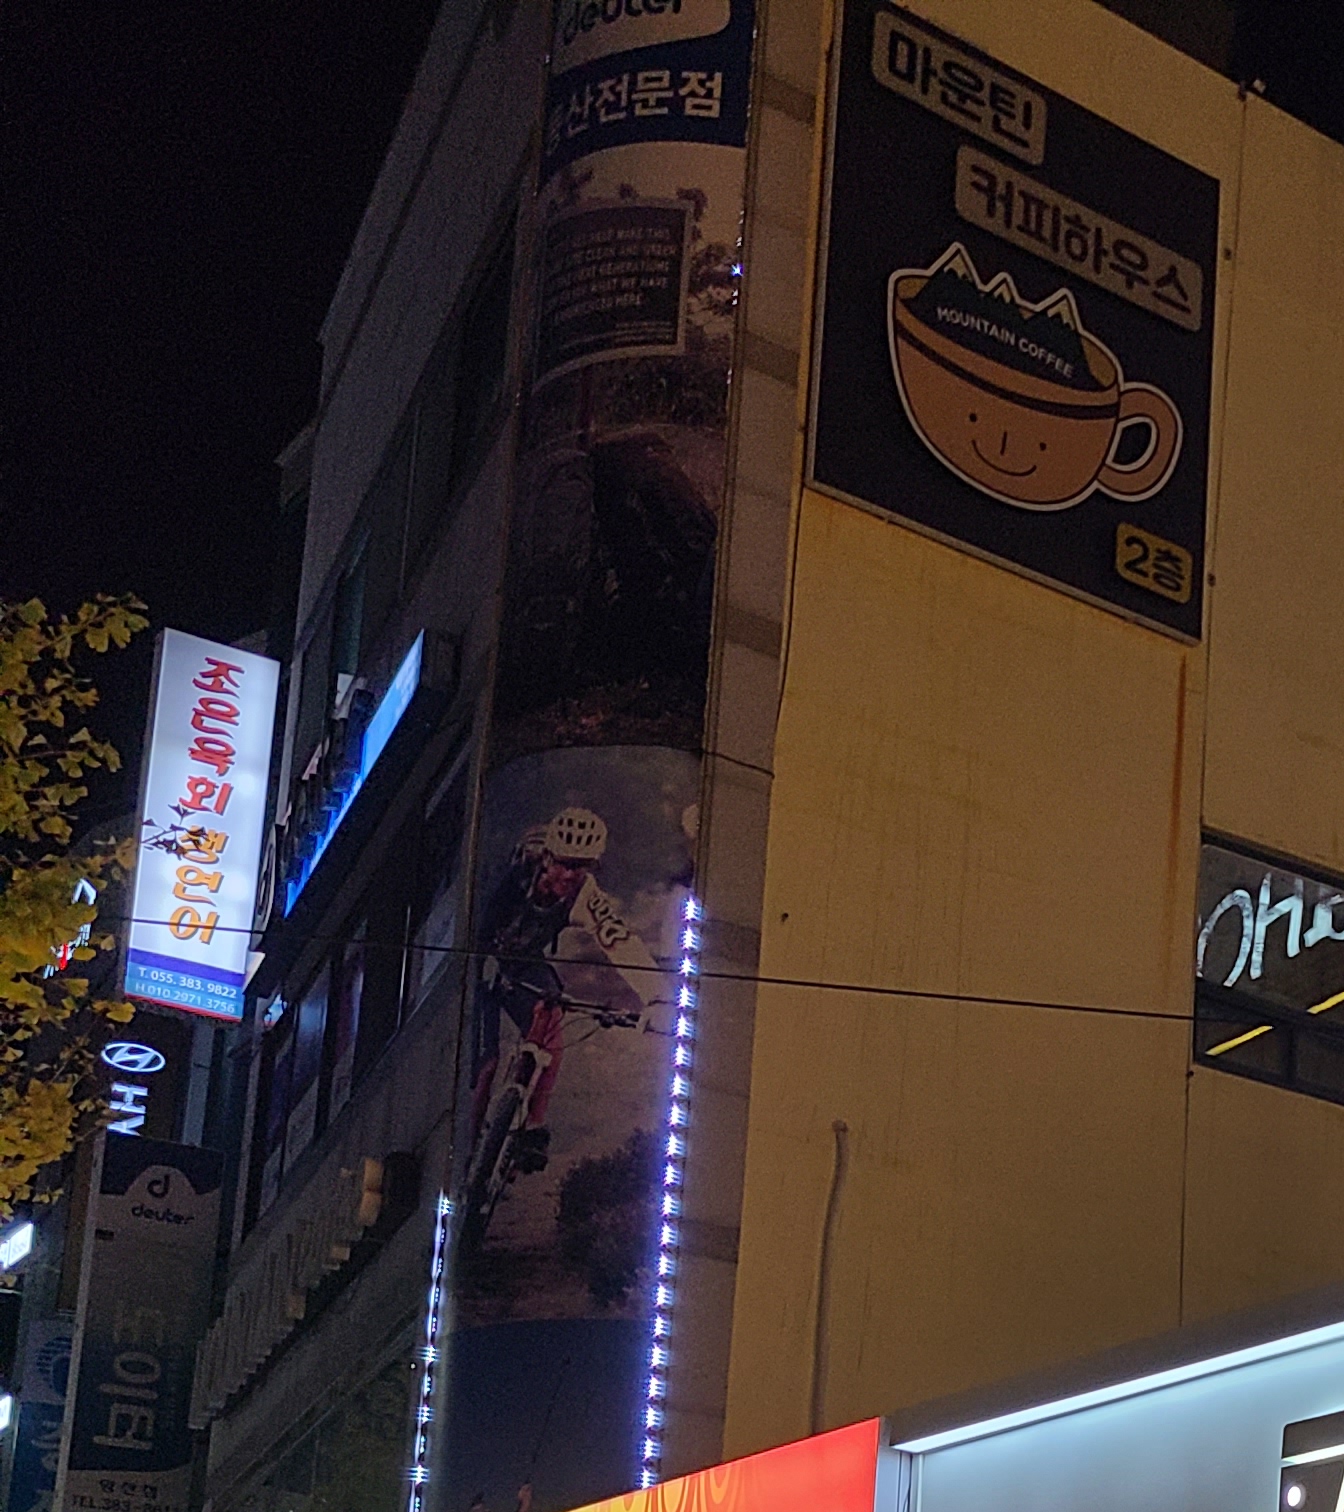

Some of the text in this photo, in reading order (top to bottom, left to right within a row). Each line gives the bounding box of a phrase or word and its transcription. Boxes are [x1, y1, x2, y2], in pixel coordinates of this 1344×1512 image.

[888, 30, 1032, 148] 마운틴
[970, 164, 1192, 314] 커피하우스
[936, 306, 1075, 380] MOUNTAIN COFFEE
[1124, 535, 1182, 593] 2층
[132, 1204, 194, 1225] deuter
